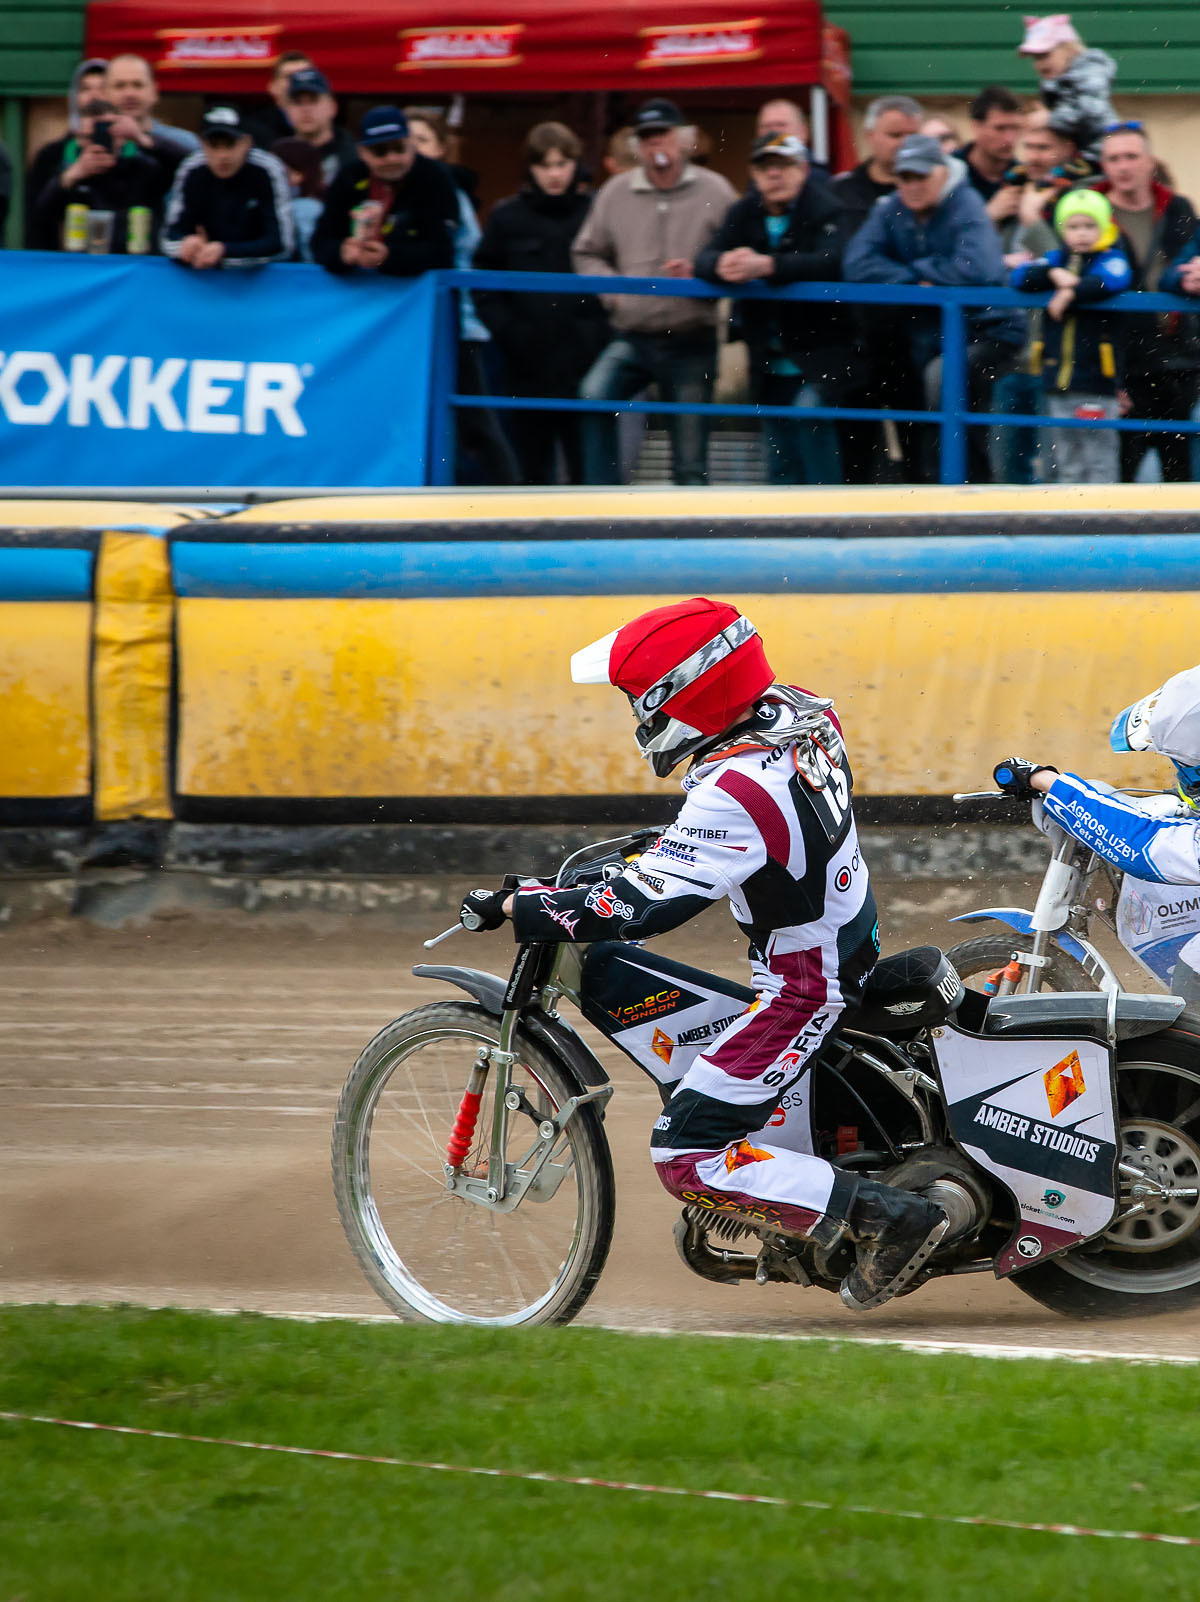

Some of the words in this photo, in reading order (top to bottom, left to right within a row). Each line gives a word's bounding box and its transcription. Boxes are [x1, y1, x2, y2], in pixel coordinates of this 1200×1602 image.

[0, 350, 308, 438] OKKER
[680, 827, 728, 840] OPTIBET
[1067, 800, 1140, 862] AGROSLUŽBY
[1073, 820, 1094, 841] Petr
[1094, 839, 1120, 863] Ryba
[658, 847, 697, 863] SERVICE
[608, 990, 680, 1018] Van2Go
[622, 1001, 677, 1024] LONDON
[677, 1023, 712, 1045] AMBER
[973, 1104, 1031, 1140] AMBER
[1029, 1123, 1101, 1164] STUDIOS
